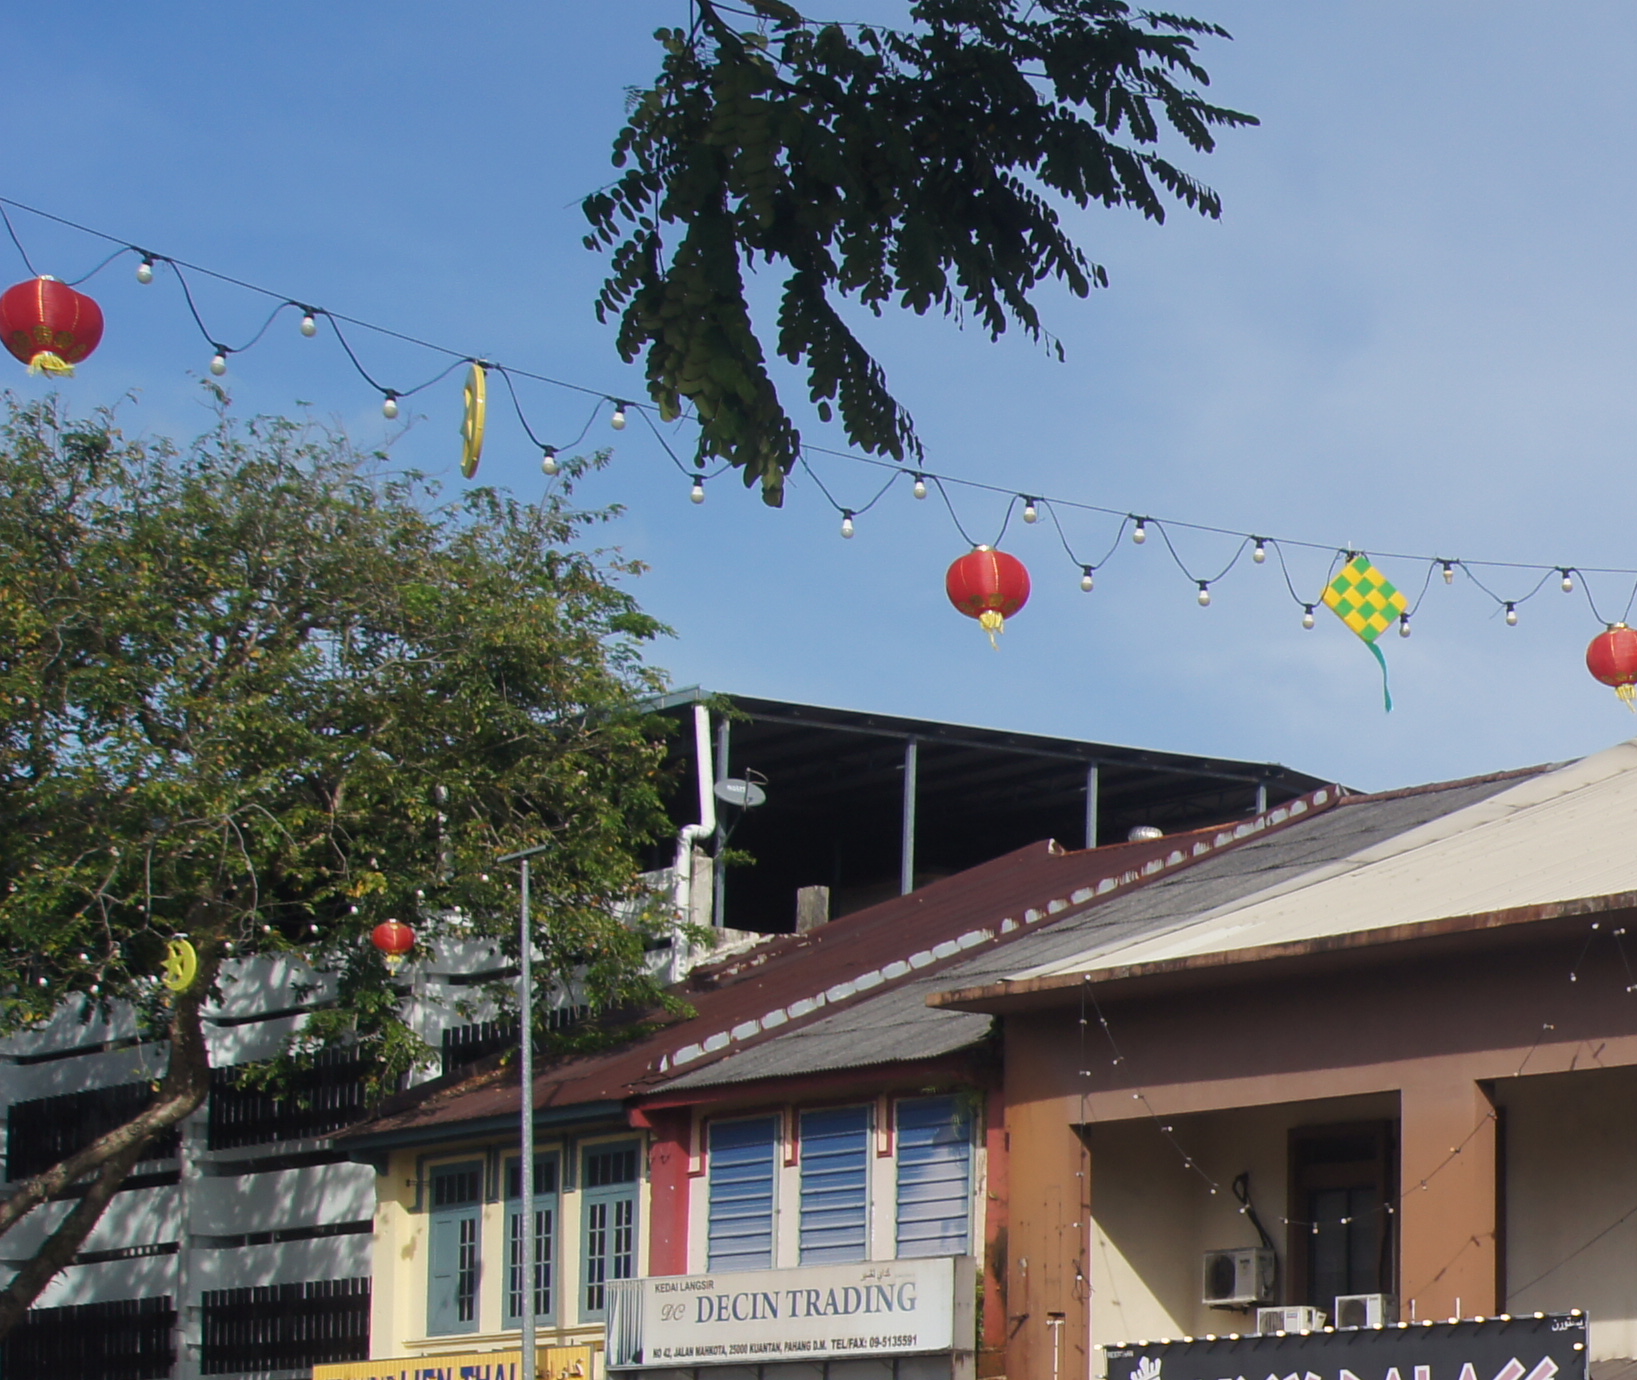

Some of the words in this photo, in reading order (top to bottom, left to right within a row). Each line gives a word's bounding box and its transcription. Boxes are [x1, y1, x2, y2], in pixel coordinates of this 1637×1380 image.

[654, 1281, 679, 1294] KEDAI
[680, 1279, 715, 1293] LANGSIR
[695, 1291, 781, 1324] DECIN
[786, 1281, 917, 1318] TRADING
[674, 1346, 694, 1357] JALAN
[750, 1342, 782, 1354] KUANTAN,
[784, 1341, 811, 1352] PAHANG
[869, 1335, 918, 1349] 09-5135591
